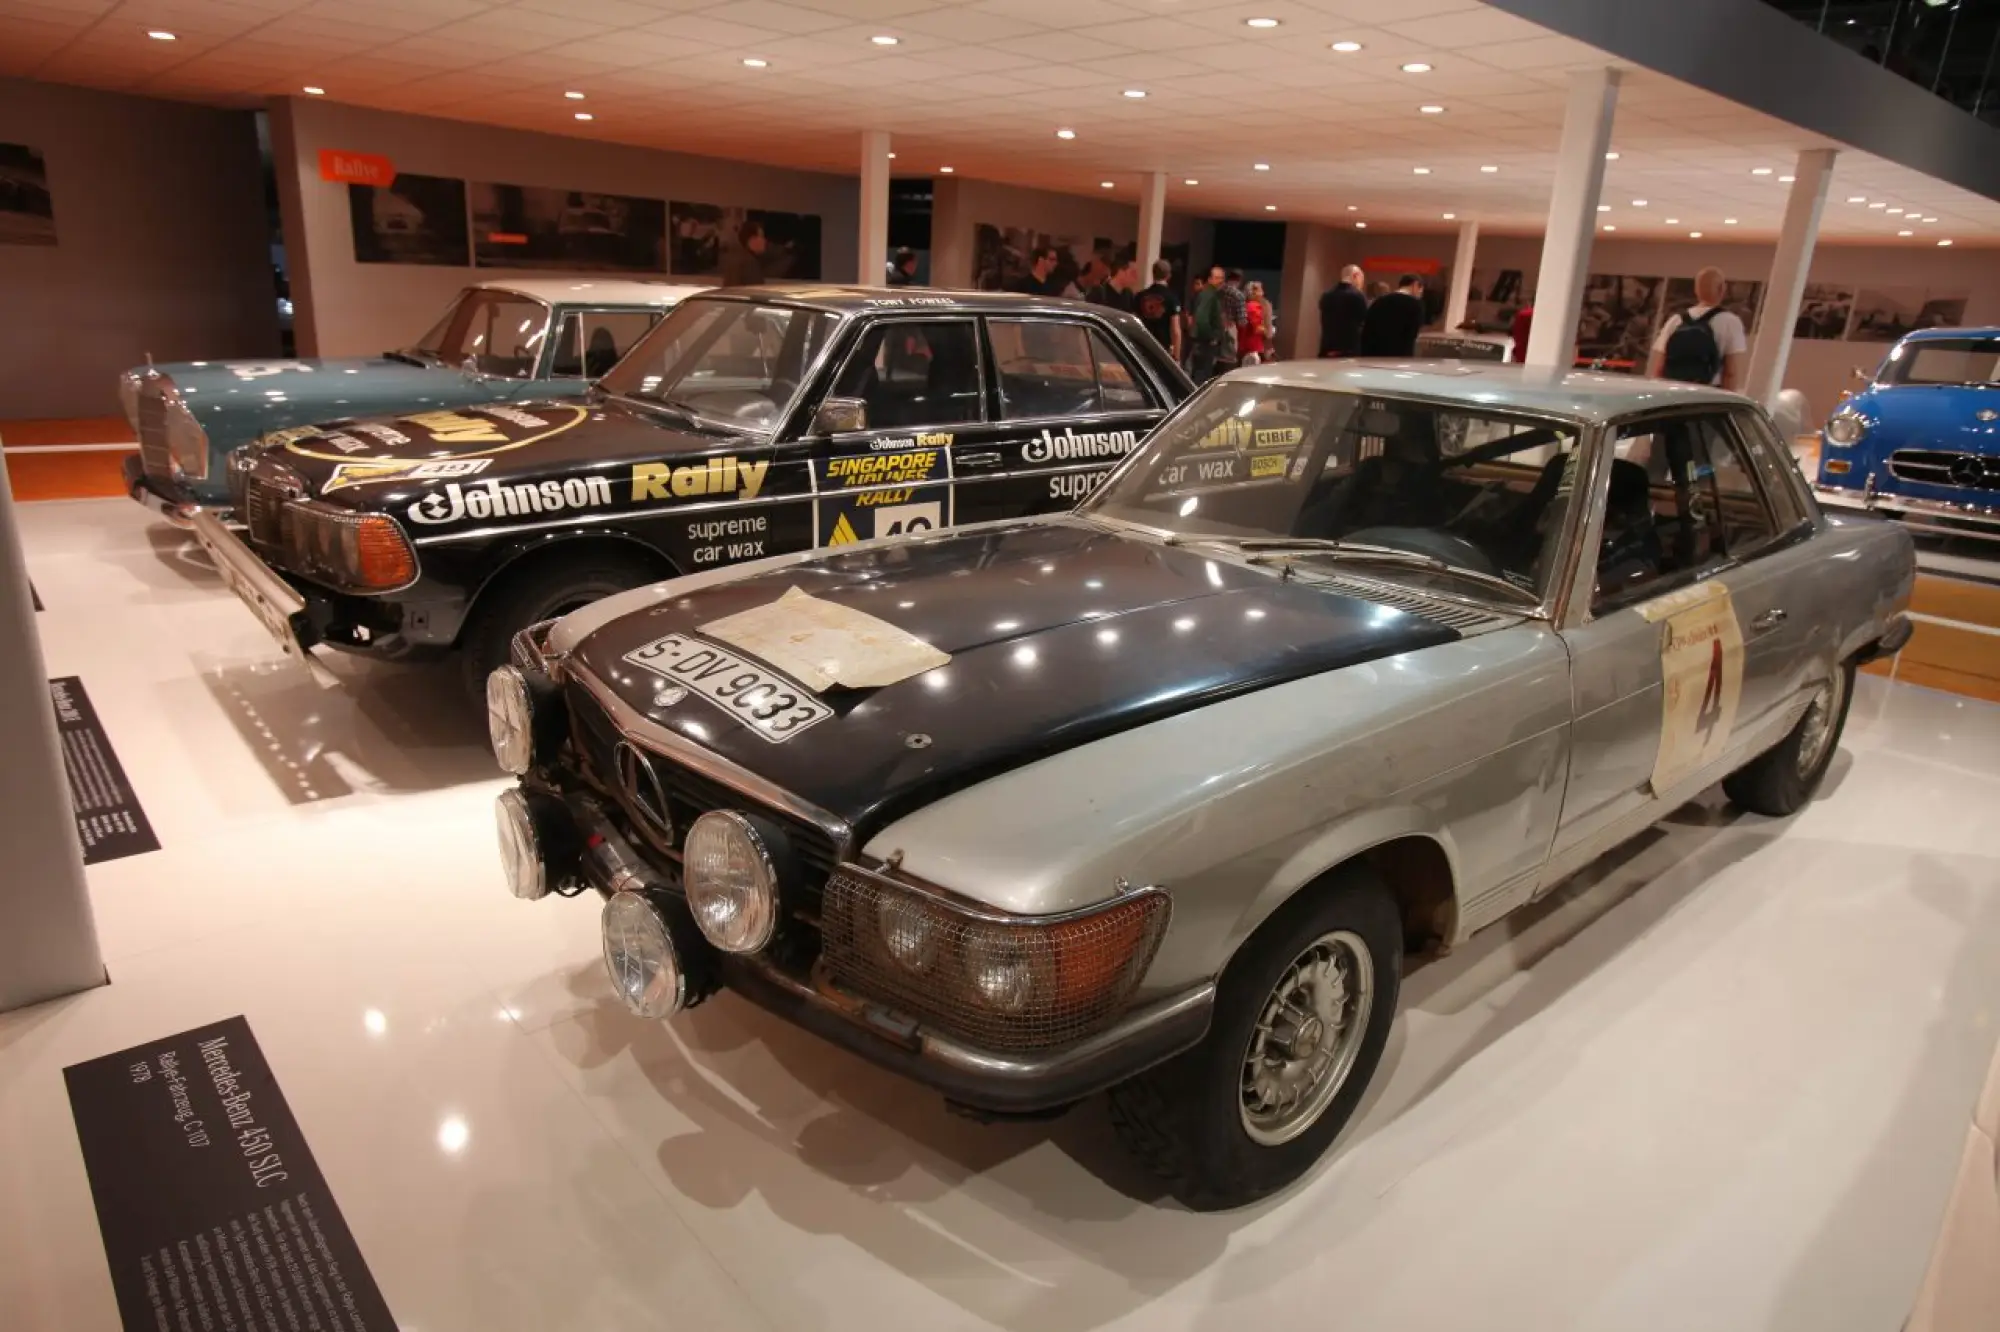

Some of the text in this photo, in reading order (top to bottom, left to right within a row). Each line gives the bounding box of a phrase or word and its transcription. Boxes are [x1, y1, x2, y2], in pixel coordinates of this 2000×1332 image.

[870, 432, 954, 451] Johnson Rally
[1021, 427, 1136, 462] Johnson
[1257, 430, 1293, 445] CIBIE
[826, 452, 938, 477] SINGAPORE
[1199, 460, 1235, 480] wax
[408, 456, 769, 524] Johnson Rally
[688, 516, 767, 541] supreme
[693, 541, 765, 563] car wax
[1695, 637, 1723, 748] 4
[129, 1061, 153, 1083] 1978
[198, 1036, 289, 1188] Mercedes-Benz 450 SLC
[183, 1120, 205, 1132] C
[187, 1130, 210, 1147] 107
